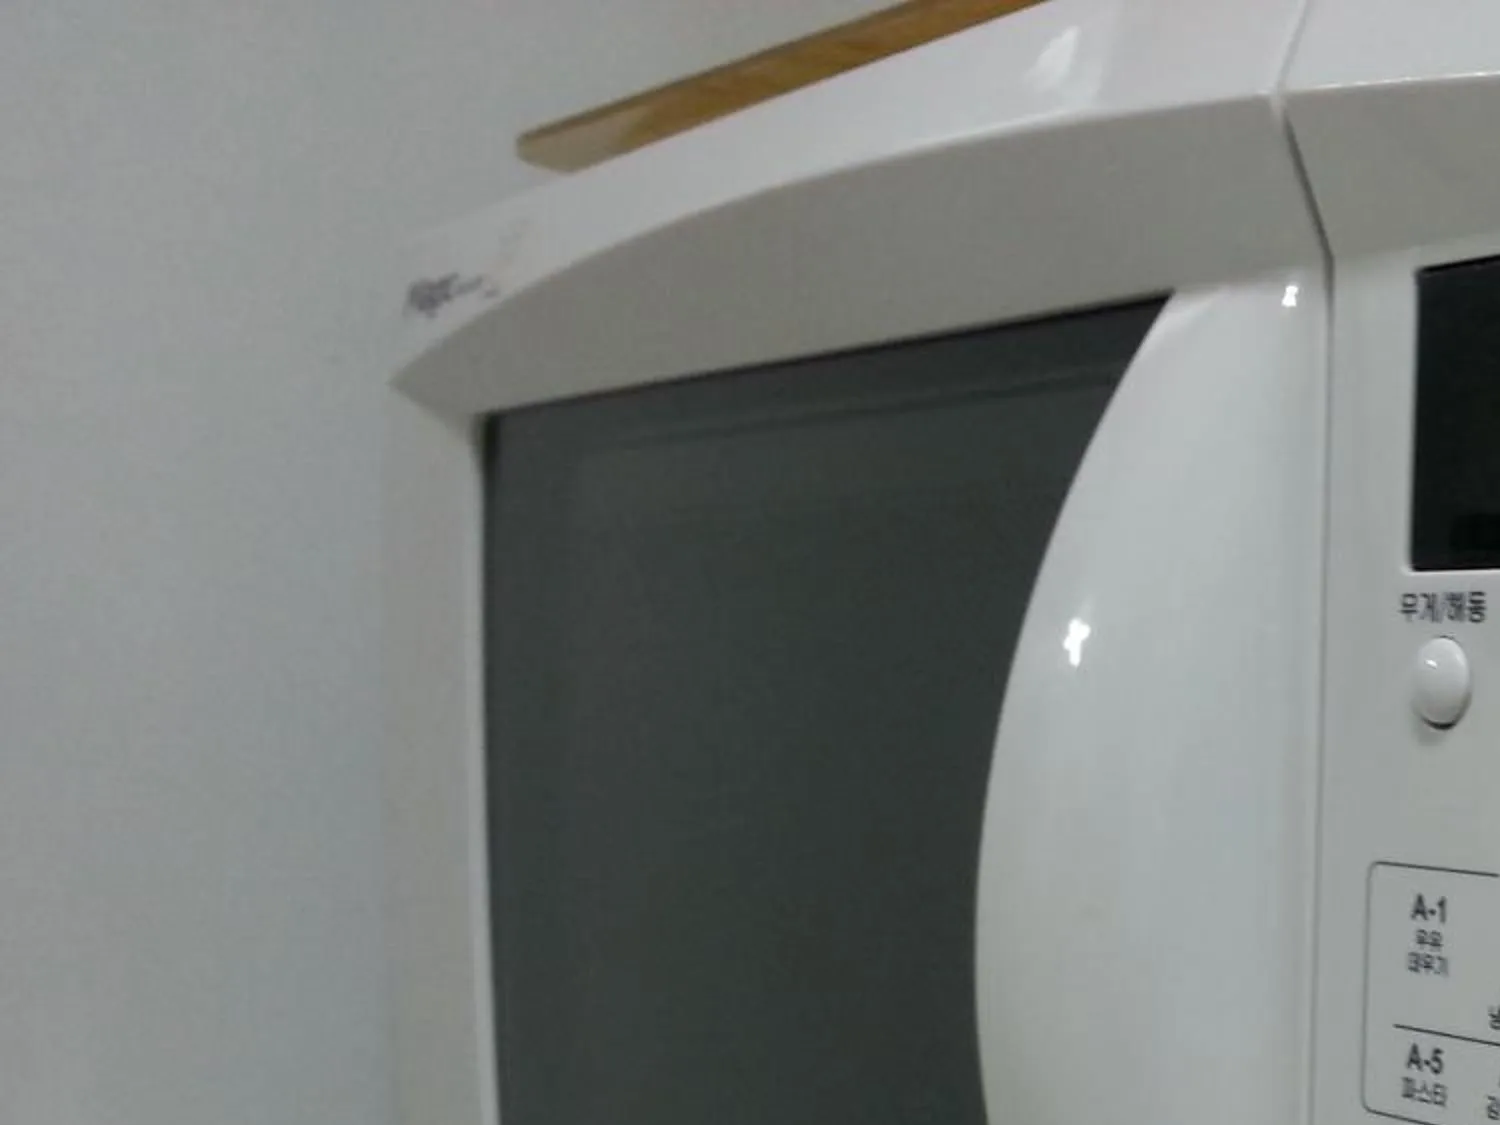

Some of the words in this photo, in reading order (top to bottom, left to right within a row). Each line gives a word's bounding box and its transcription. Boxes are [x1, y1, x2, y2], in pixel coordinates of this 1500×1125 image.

[1399, 591, 1488, 623] 무게/해동
[1410, 893, 1448, 924] A-1
[1406, 1043, 1445, 1076] A-5
